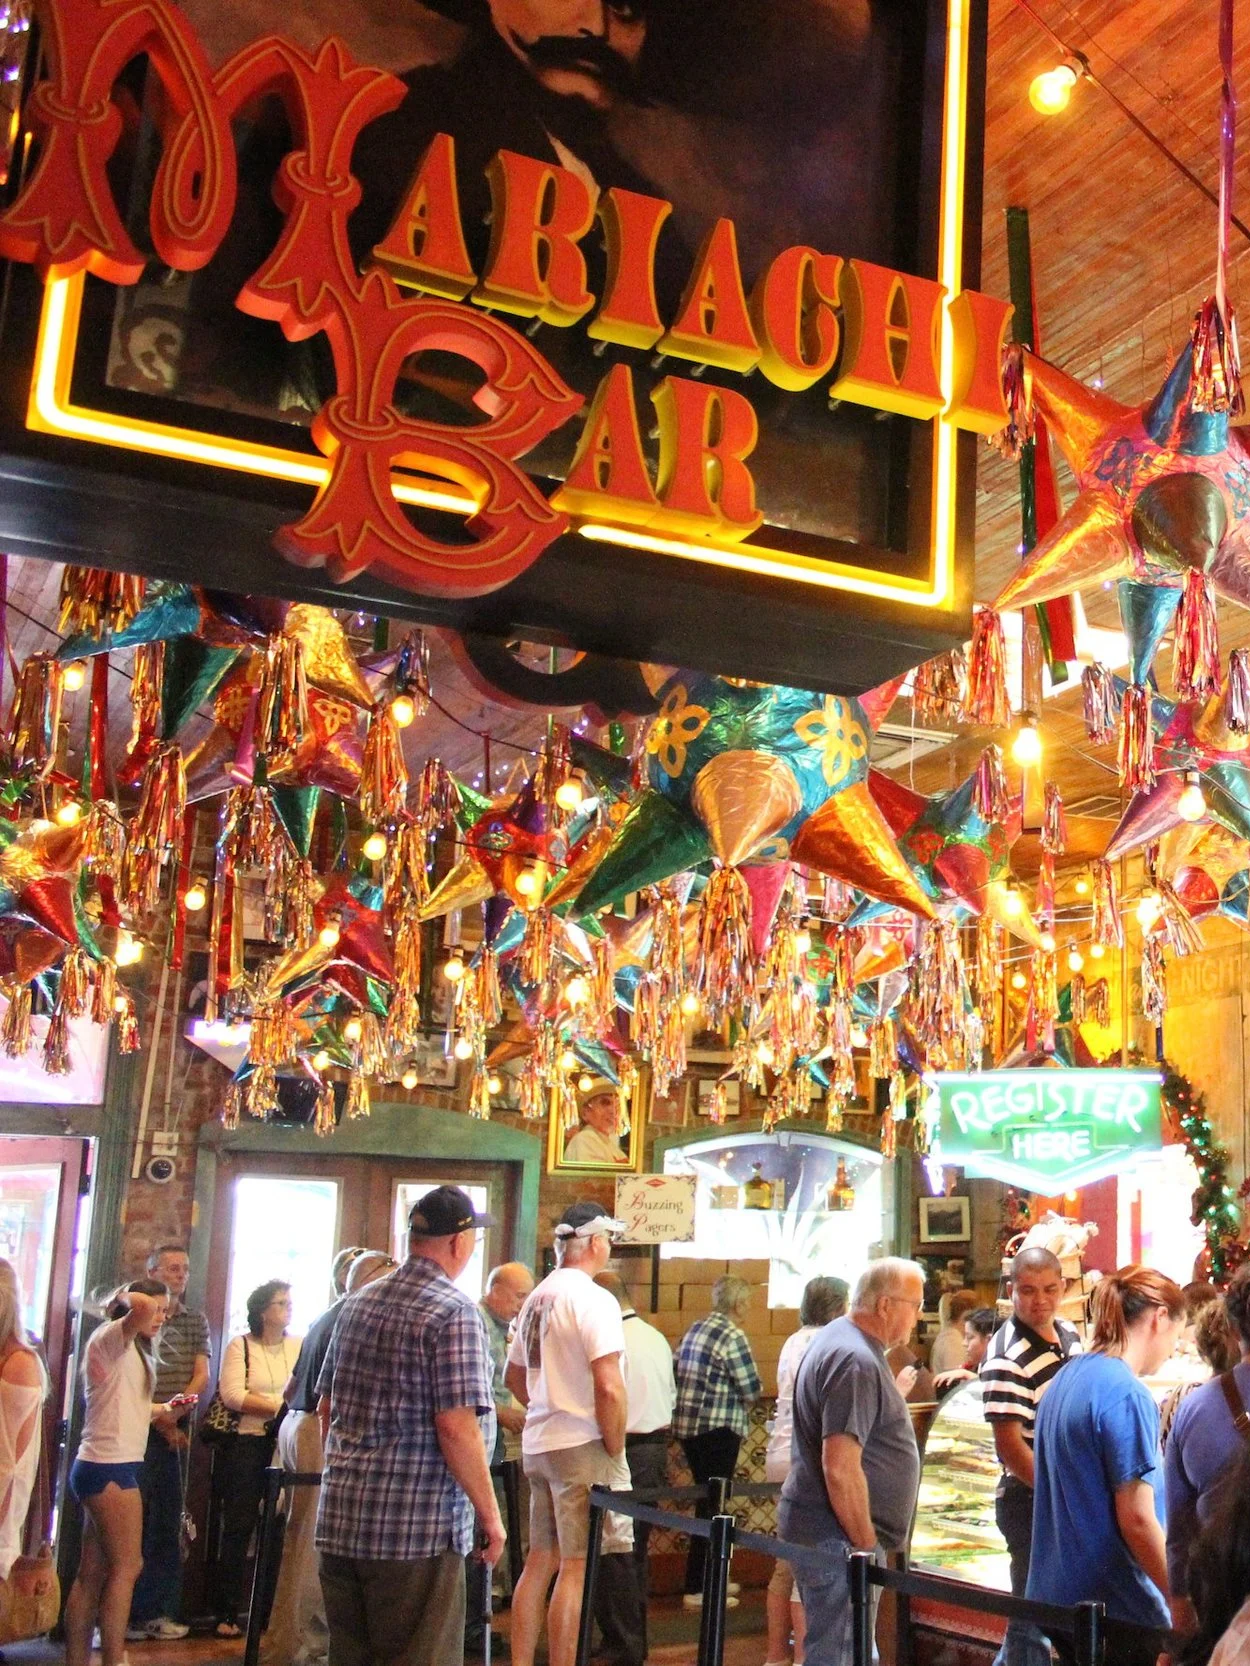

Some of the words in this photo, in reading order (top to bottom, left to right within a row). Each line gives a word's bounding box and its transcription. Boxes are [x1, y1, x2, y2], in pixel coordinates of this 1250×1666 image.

[0, 0, 1016, 434] MARIACHI
[273, 270, 763, 598] BAR
[949, 1080, 1149, 1134] REGISTER
[1011, 1129, 1091, 1162] HERE
[625, 1191, 684, 1214] Buzzing
[629, 1214, 676, 1236] Pagers
